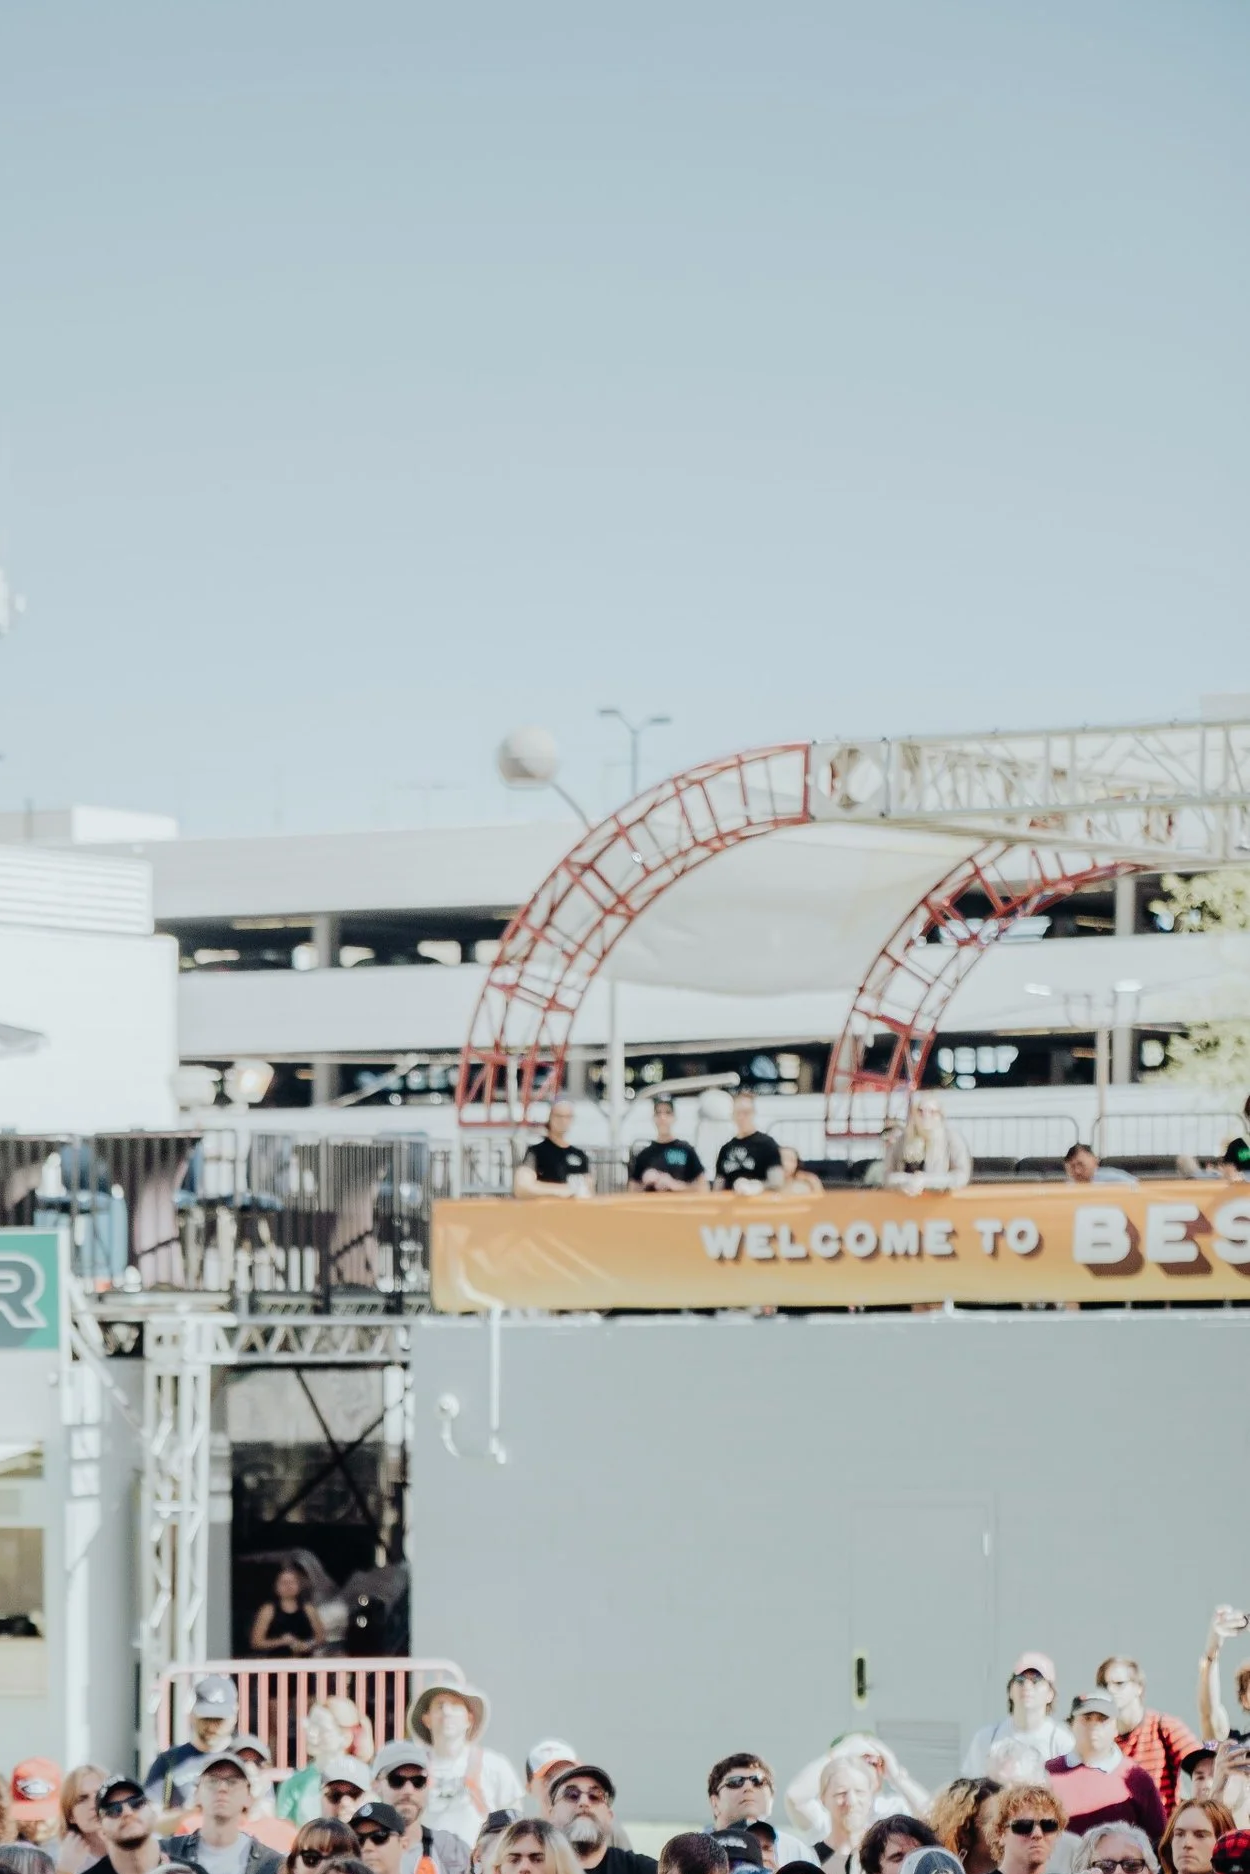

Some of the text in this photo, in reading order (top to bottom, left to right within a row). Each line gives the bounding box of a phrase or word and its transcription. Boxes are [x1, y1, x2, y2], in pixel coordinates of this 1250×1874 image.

[700, 1198, 1250, 1267] WELCOME TO BES
